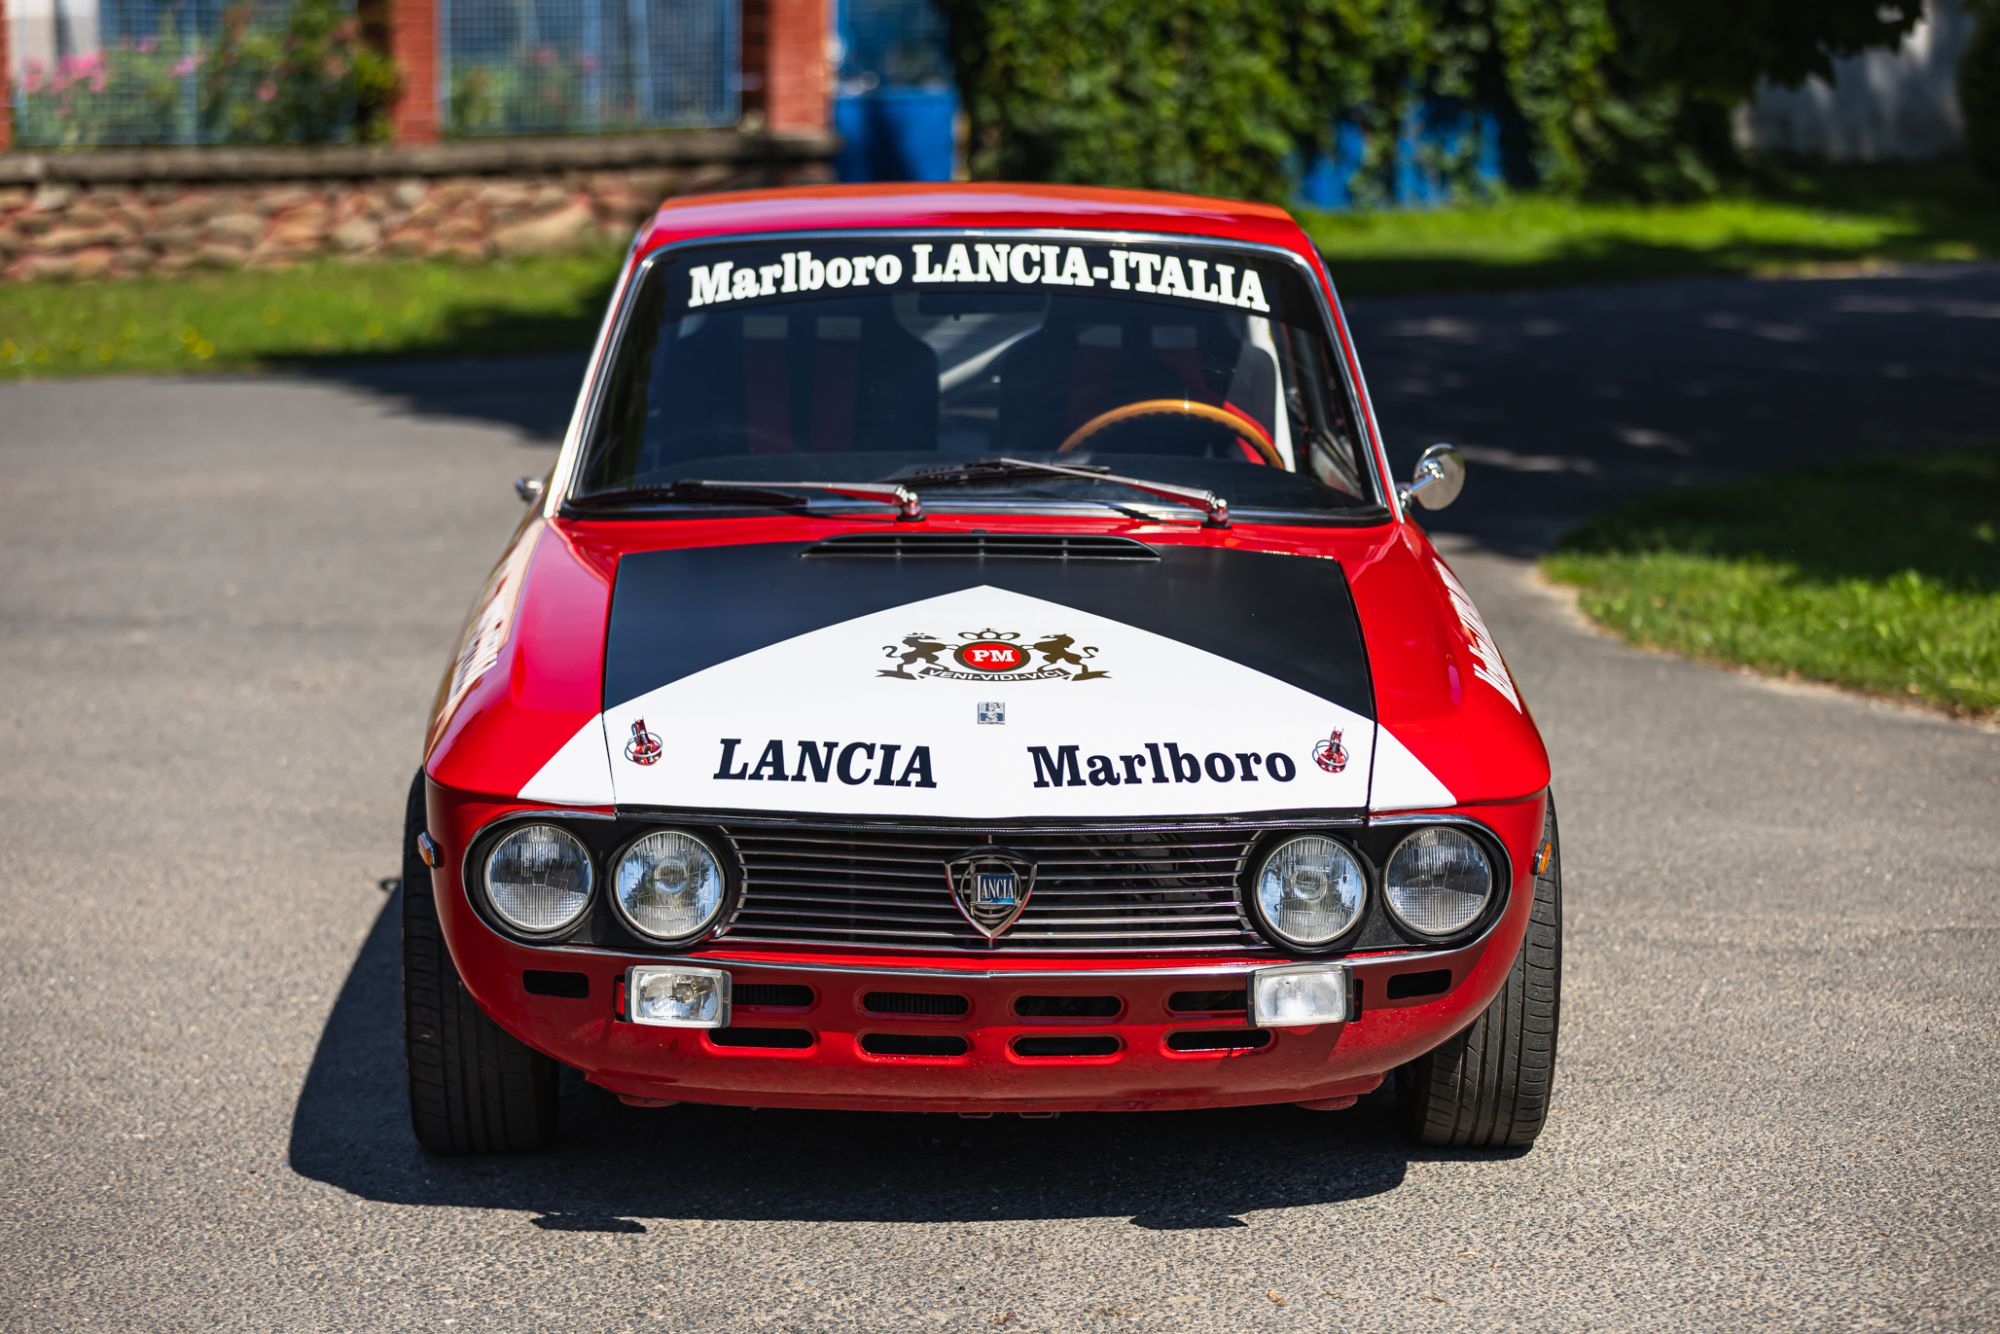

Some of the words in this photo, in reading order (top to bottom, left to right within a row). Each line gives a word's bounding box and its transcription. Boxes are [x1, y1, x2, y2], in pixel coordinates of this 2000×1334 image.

[688, 251, 902, 307] Marlboro
[911, 243, 1270, 312] LANCIA-ITALIA
[971, 649, 1015, 663] PM
[929, 669, 1065, 681] VENI-VIDI-VICI
[713, 739, 938, 788] LANCIA
[1027, 743, 1297, 788] Marlboro
[977, 875, 1015, 903] LANCIA
